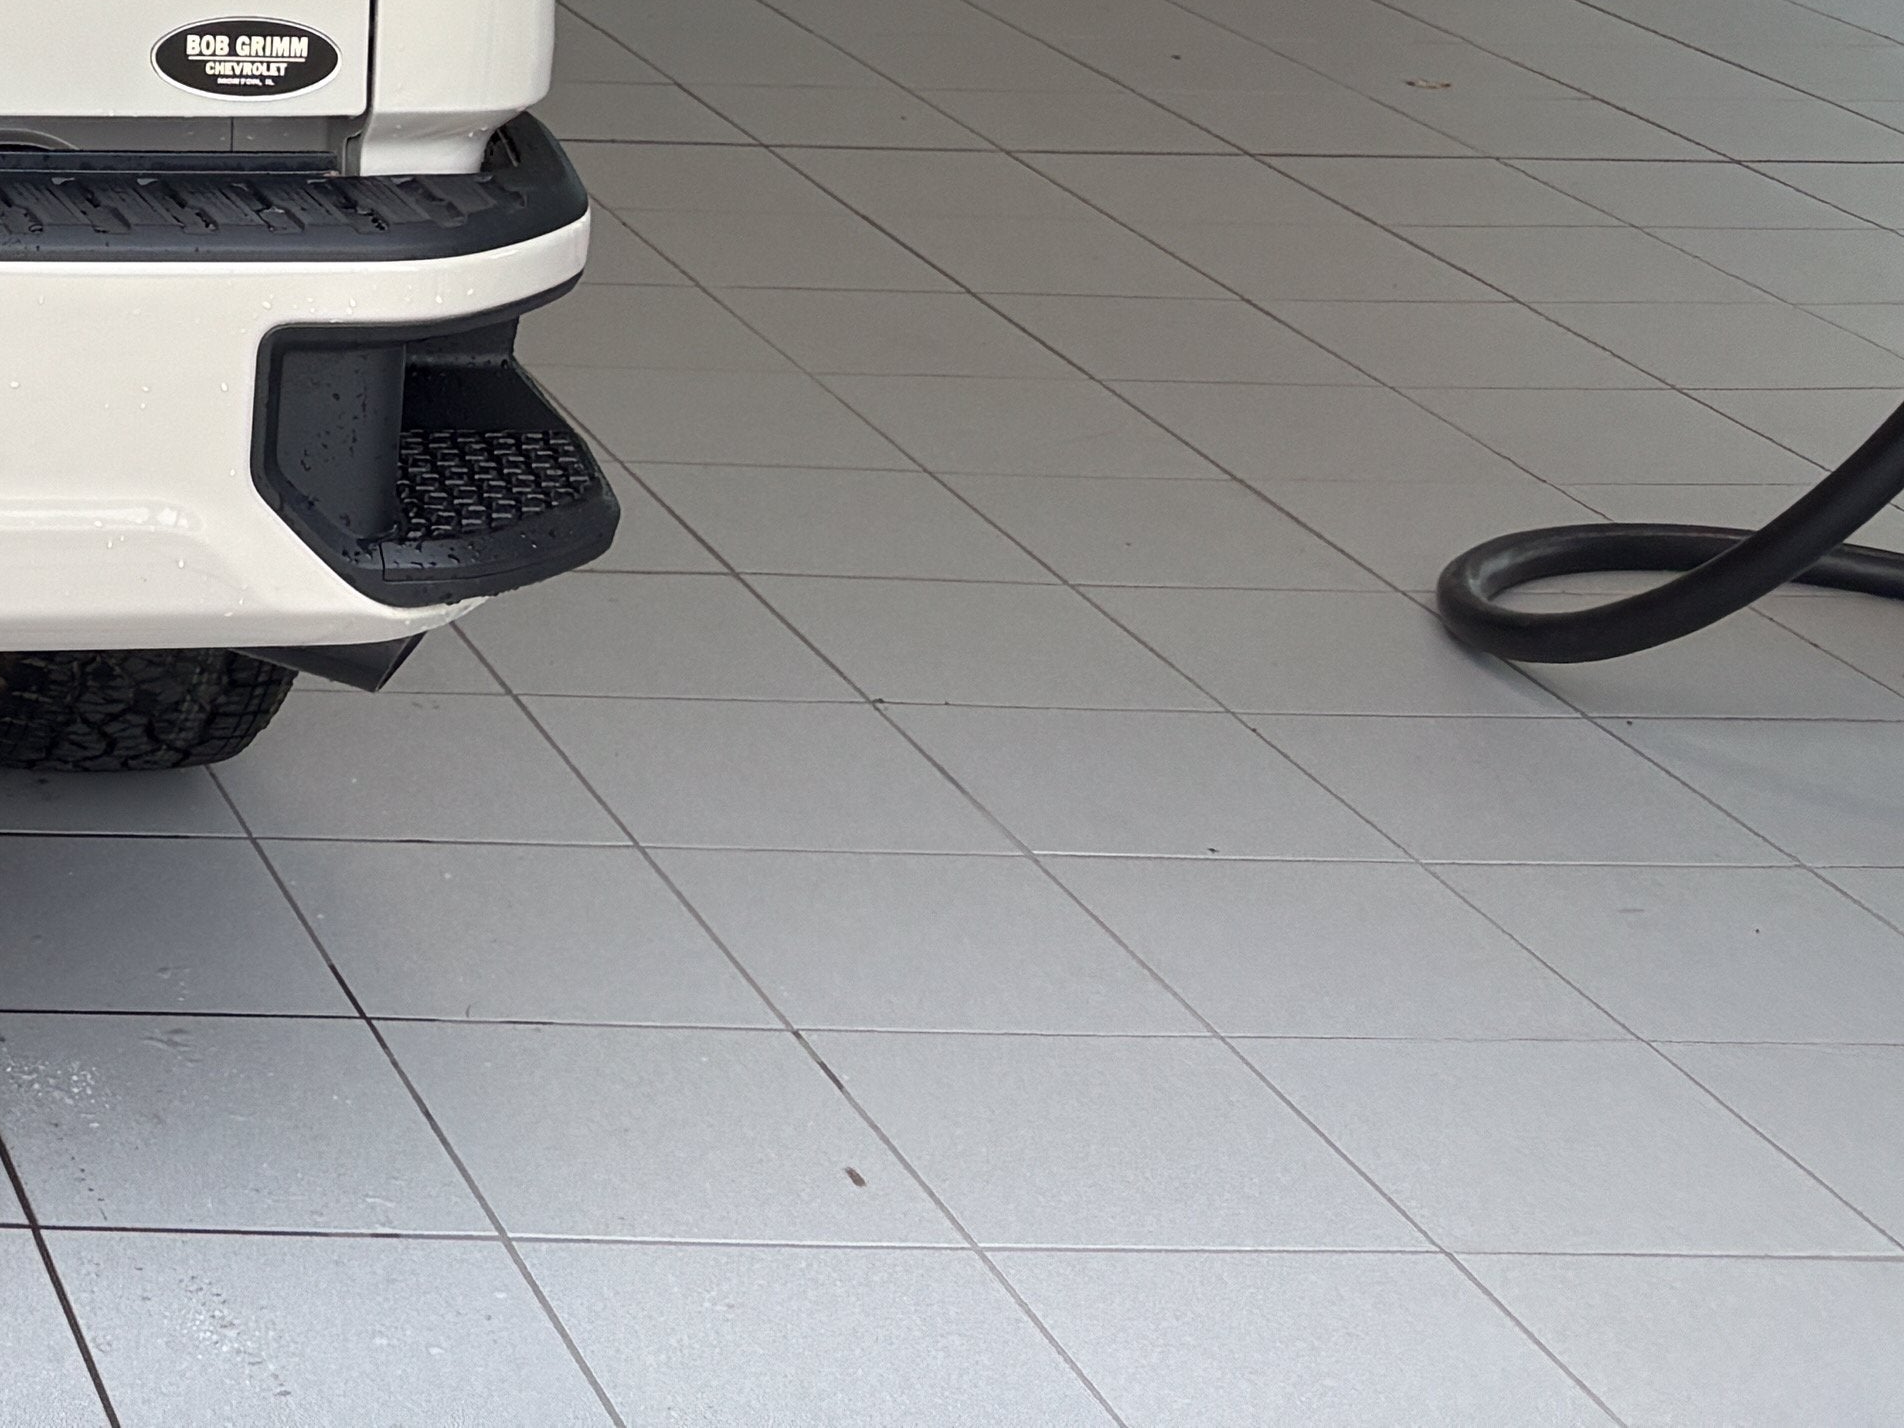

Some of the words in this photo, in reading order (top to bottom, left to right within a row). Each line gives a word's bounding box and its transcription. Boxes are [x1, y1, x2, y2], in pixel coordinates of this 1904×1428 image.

[186, 34, 230, 56] BOB
[235, 35, 309, 58] GRIMM
[205, 61, 288, 76] CHEVROLET
